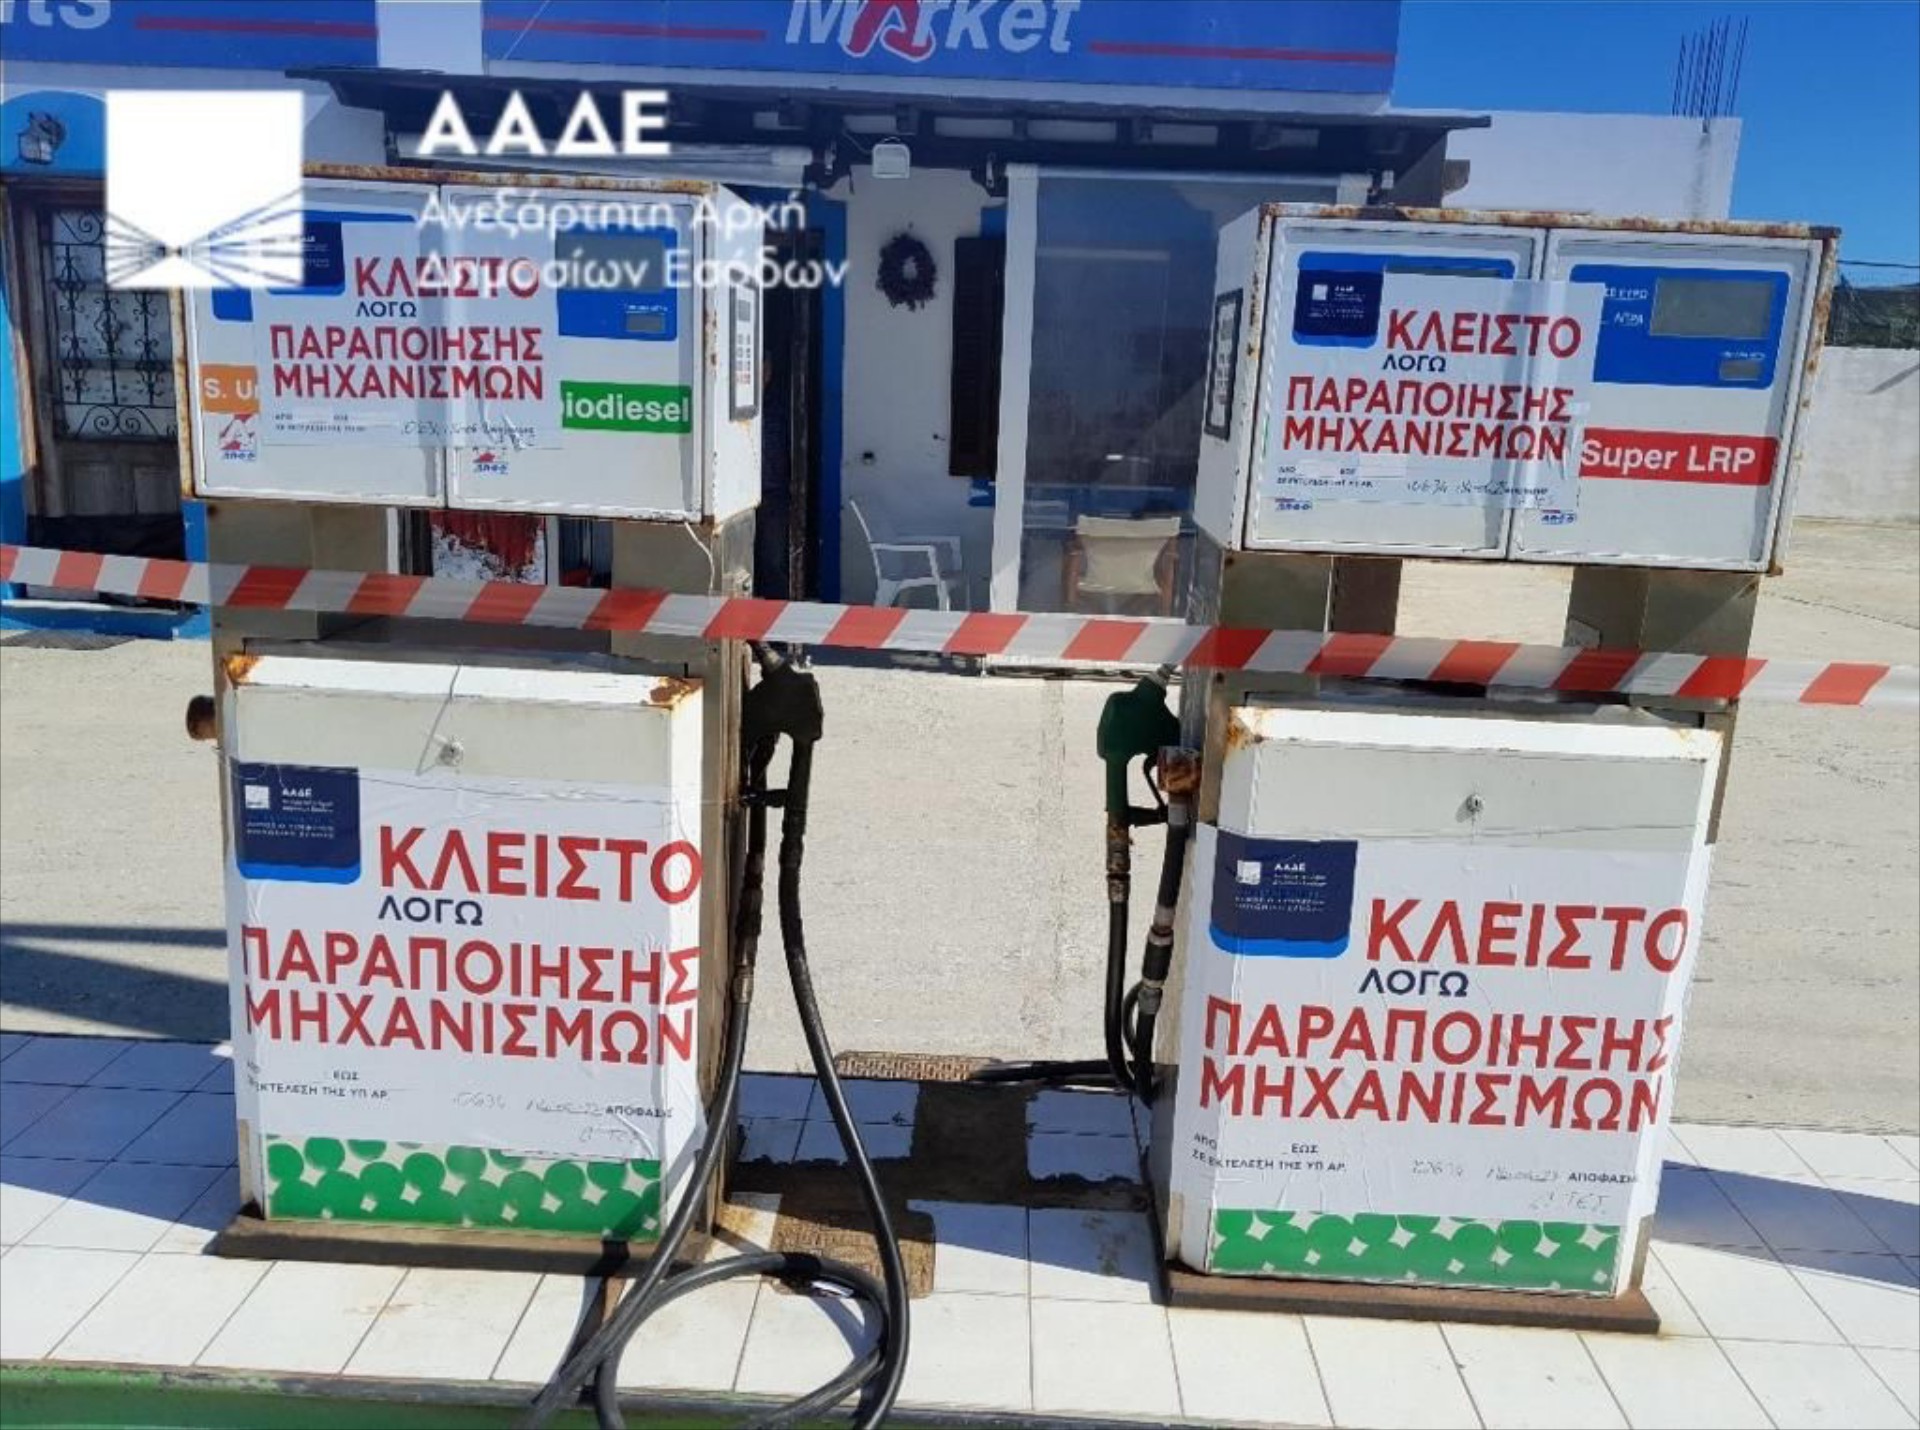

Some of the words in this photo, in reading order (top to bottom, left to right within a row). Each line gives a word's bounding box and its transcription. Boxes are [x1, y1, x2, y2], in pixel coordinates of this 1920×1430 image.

[356, 301, 417, 318] ΛΟΓΩ
[270, 324, 543, 362] ΠΑΡΑΠΟΙΗΣΗΣ
[1387, 308, 1582, 359] ΚΛΕΙΣΤΟ
[273, 363, 543, 401] ΜΗΧΑΝΙΣΜΩΝ
[1382, 354, 1447, 373] ΛΟΓΩ
[1286, 376, 1574, 424] ΠΑΡΑΠΟΙΗΣΗΣ
[1283, 415, 1568, 461] ΜΗΧΑΝΙΣΜΩΝ
[1582, 438, 1679, 476] Super
[1686, 444, 1756, 473] LRP
[379, 825, 702, 906] ΚΛΕΙΣΤΟ
[378, 895, 484, 926] ΛΟΓΩ
[1366, 898, 1689, 973] ΚΛΕΙΣΤΟ
[242, 924, 701, 1006] ΠΑΡΑΠΟΙΗΣΗΣ
[1358, 968, 1470, 997] ΛΟΓΩ
[245, 985, 694, 1066] ΜΗΧΑΝΙΣΜΩΝ
[1204, 995, 1674, 1073] ΠΑΡΑΠΟΙΗΣΗΣ
[1199, 1056, 1663, 1133] ΜΗΧΑΝΙΣΜΩΝ
[1291, 1143, 1319, 1154] ΕΩΣ
